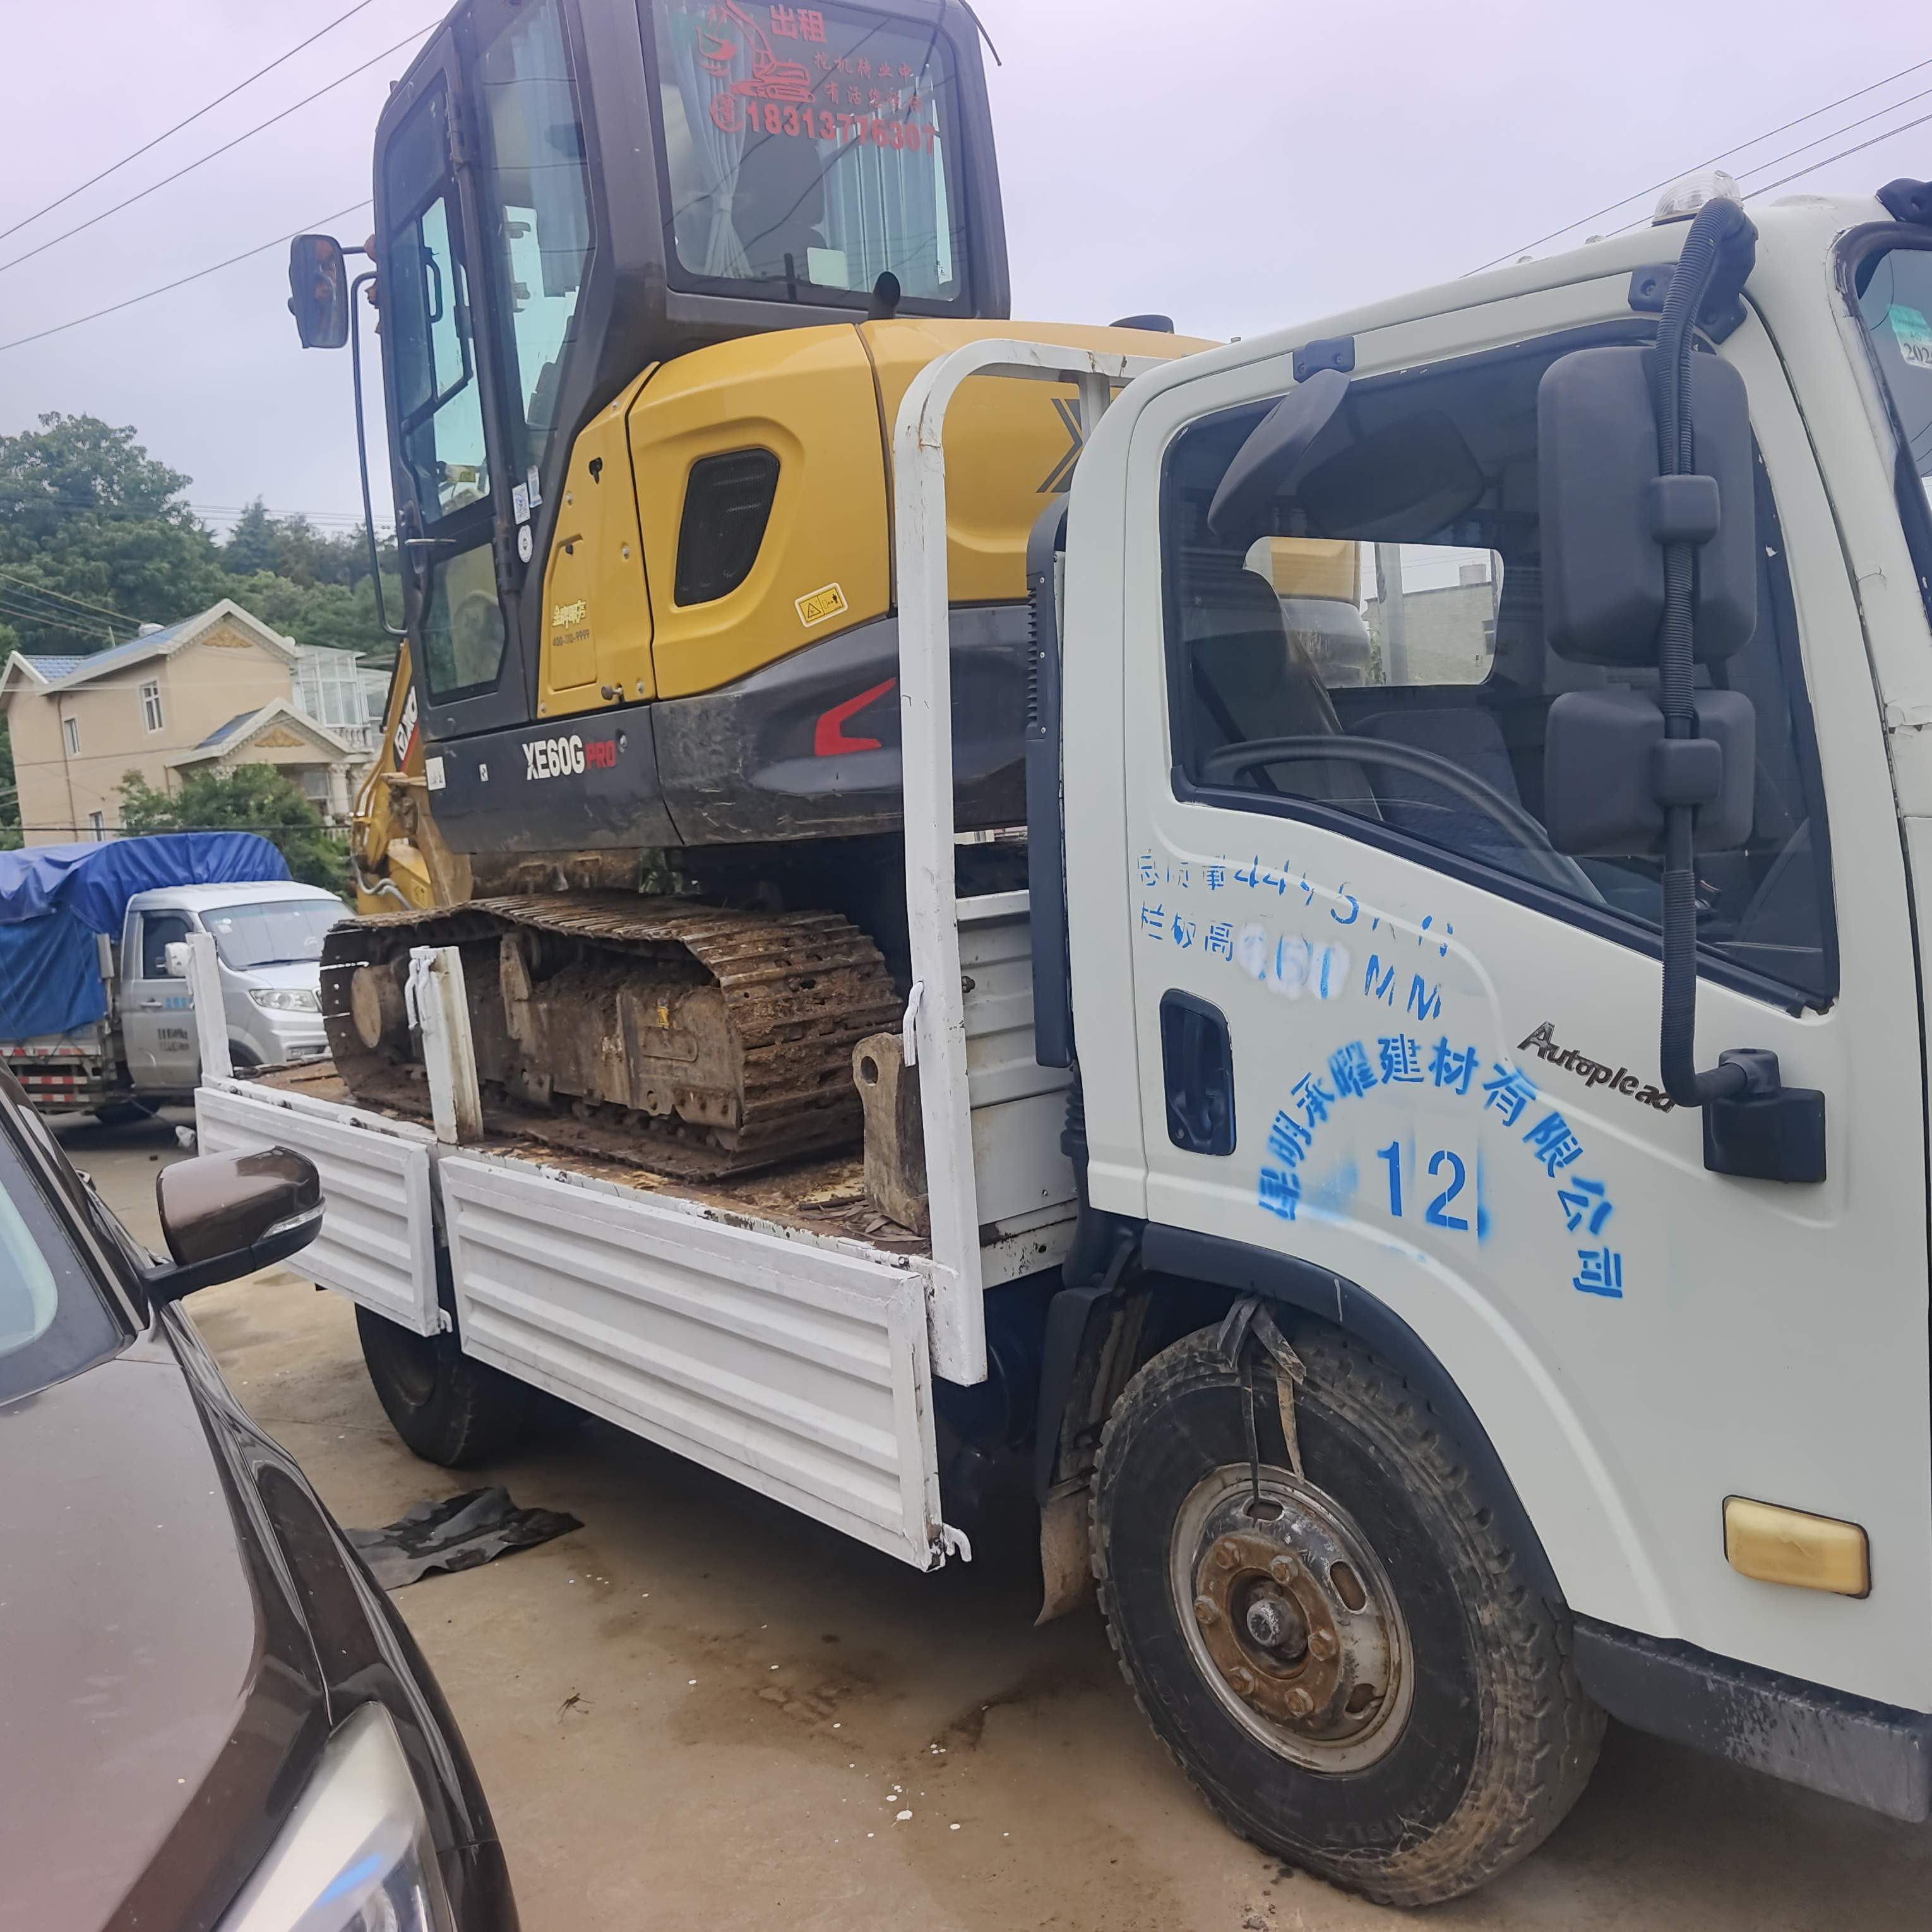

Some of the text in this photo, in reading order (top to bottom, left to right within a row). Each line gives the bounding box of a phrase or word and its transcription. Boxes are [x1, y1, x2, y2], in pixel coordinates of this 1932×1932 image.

[770, 3, 826, 43] 出租
[747, 100, 936, 155] 18313776307
[1904, 342, 1932, 364] 202
[522, 734, 585, 780] XE60G
[586, 740, 617, 770] PRO
[1376, 1141, 1469, 1231] 12
